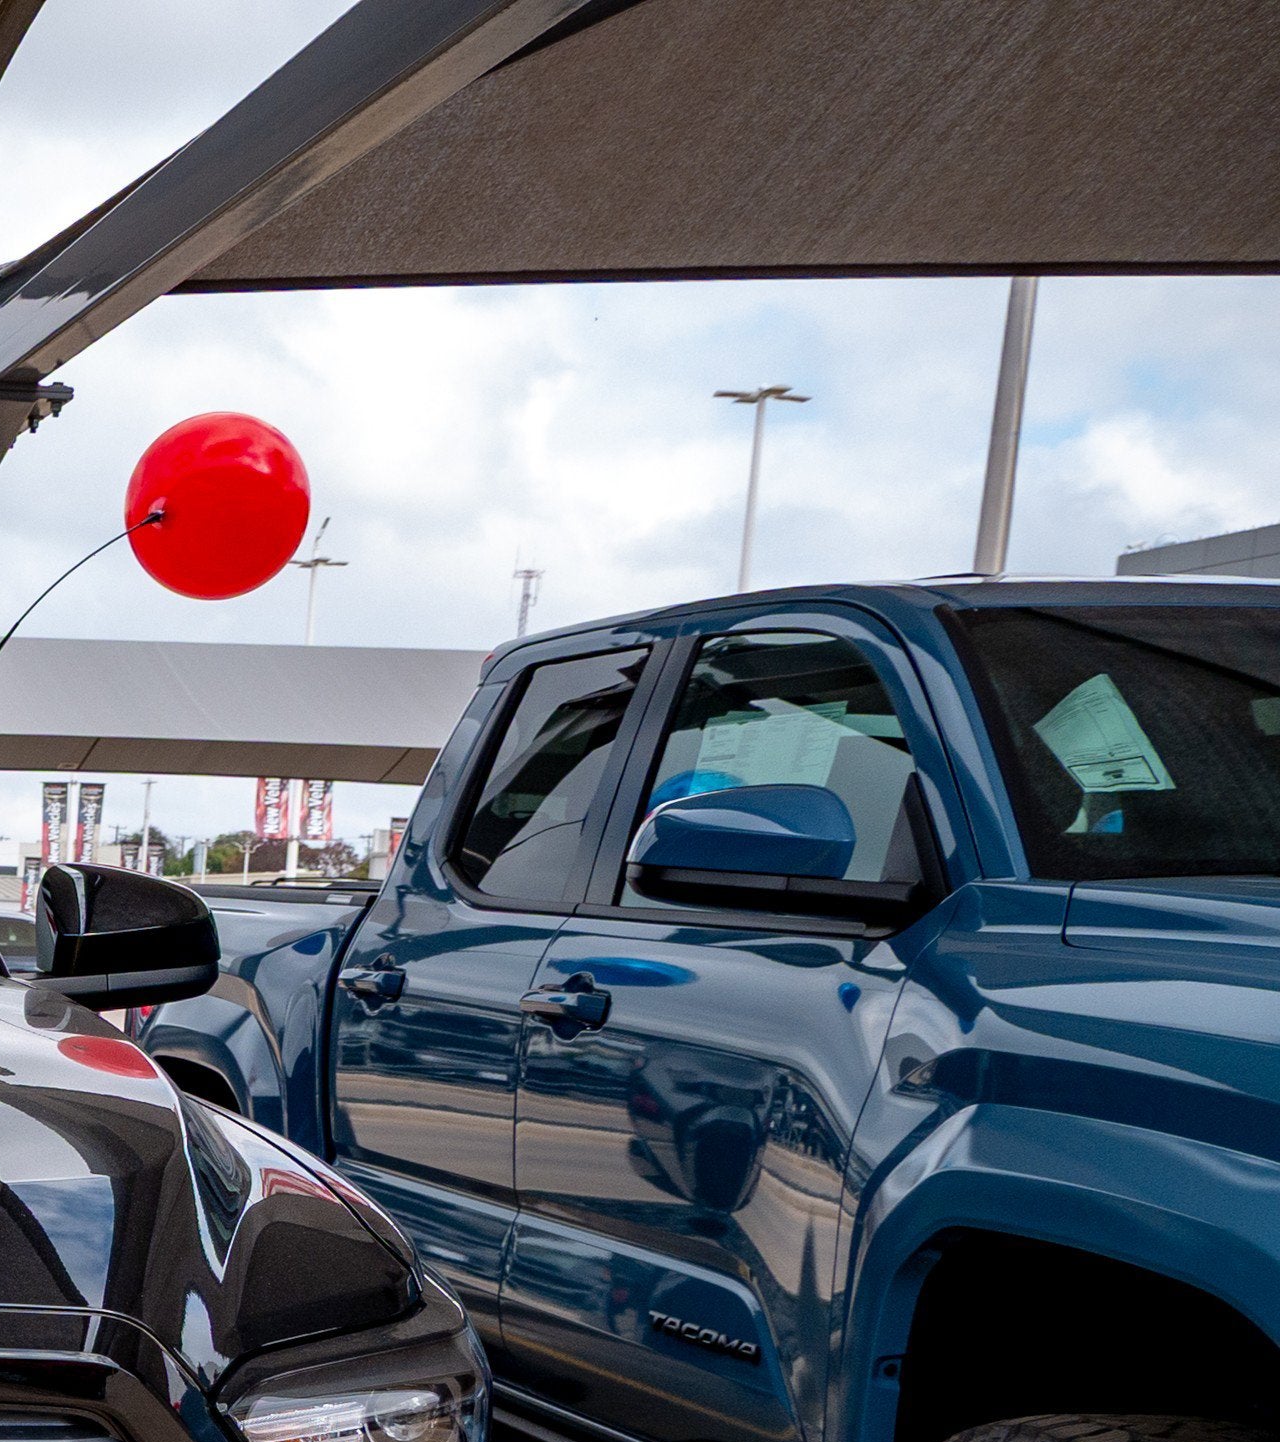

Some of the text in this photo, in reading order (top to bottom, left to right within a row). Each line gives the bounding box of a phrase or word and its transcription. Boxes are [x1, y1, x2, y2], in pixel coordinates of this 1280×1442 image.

[48, 802, 61, 841] Vehicles
[82, 803, 96, 841] Vehicles
[263, 806, 280, 834] New
[306, 809, 324, 836] New
[48, 841, 60, 863] New
[648, 1310, 759, 1357] TACOMA
